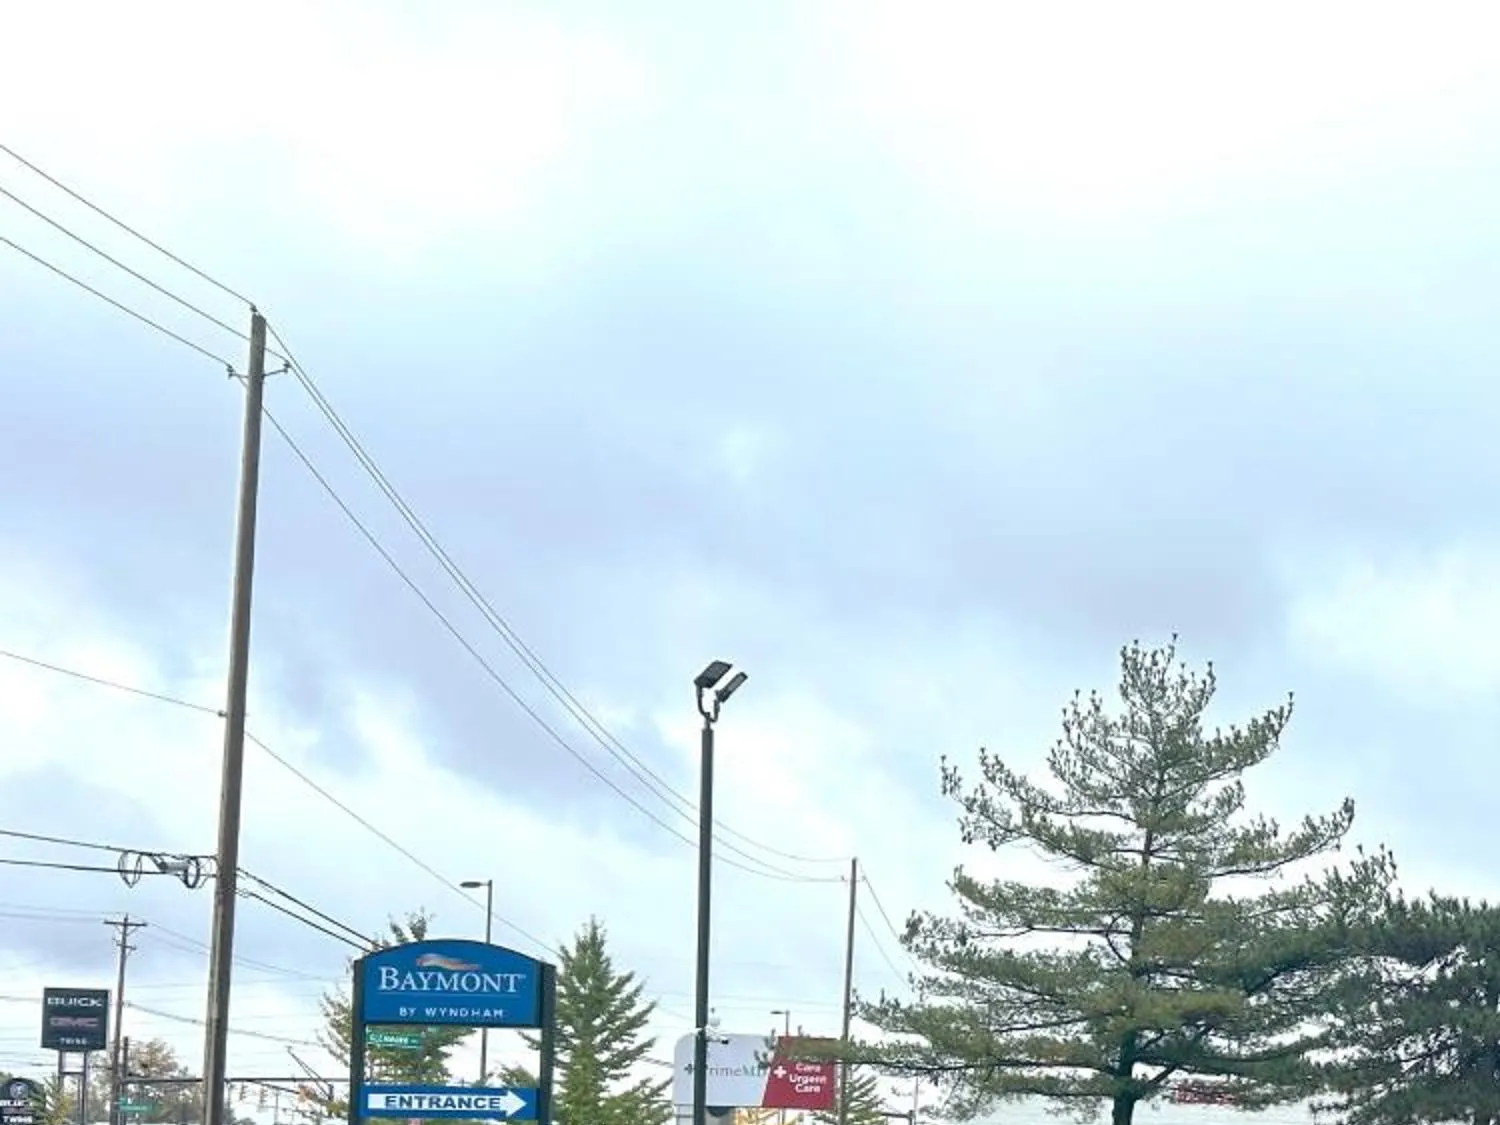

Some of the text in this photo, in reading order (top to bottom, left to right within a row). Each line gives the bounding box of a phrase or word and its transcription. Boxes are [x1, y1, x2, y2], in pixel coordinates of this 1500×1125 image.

[378, 966, 522, 993] BAYMONT
[47, 997, 103, 1007] BUICK
[399, 1007, 503, 1018] BY WYNDHAM
[795, 1062, 821, 1073] Care
[789, 1074, 827, 1086] Urgent
[795, 1084, 820, 1093] Care
[384, 1096, 501, 1109] ENTRANCE
